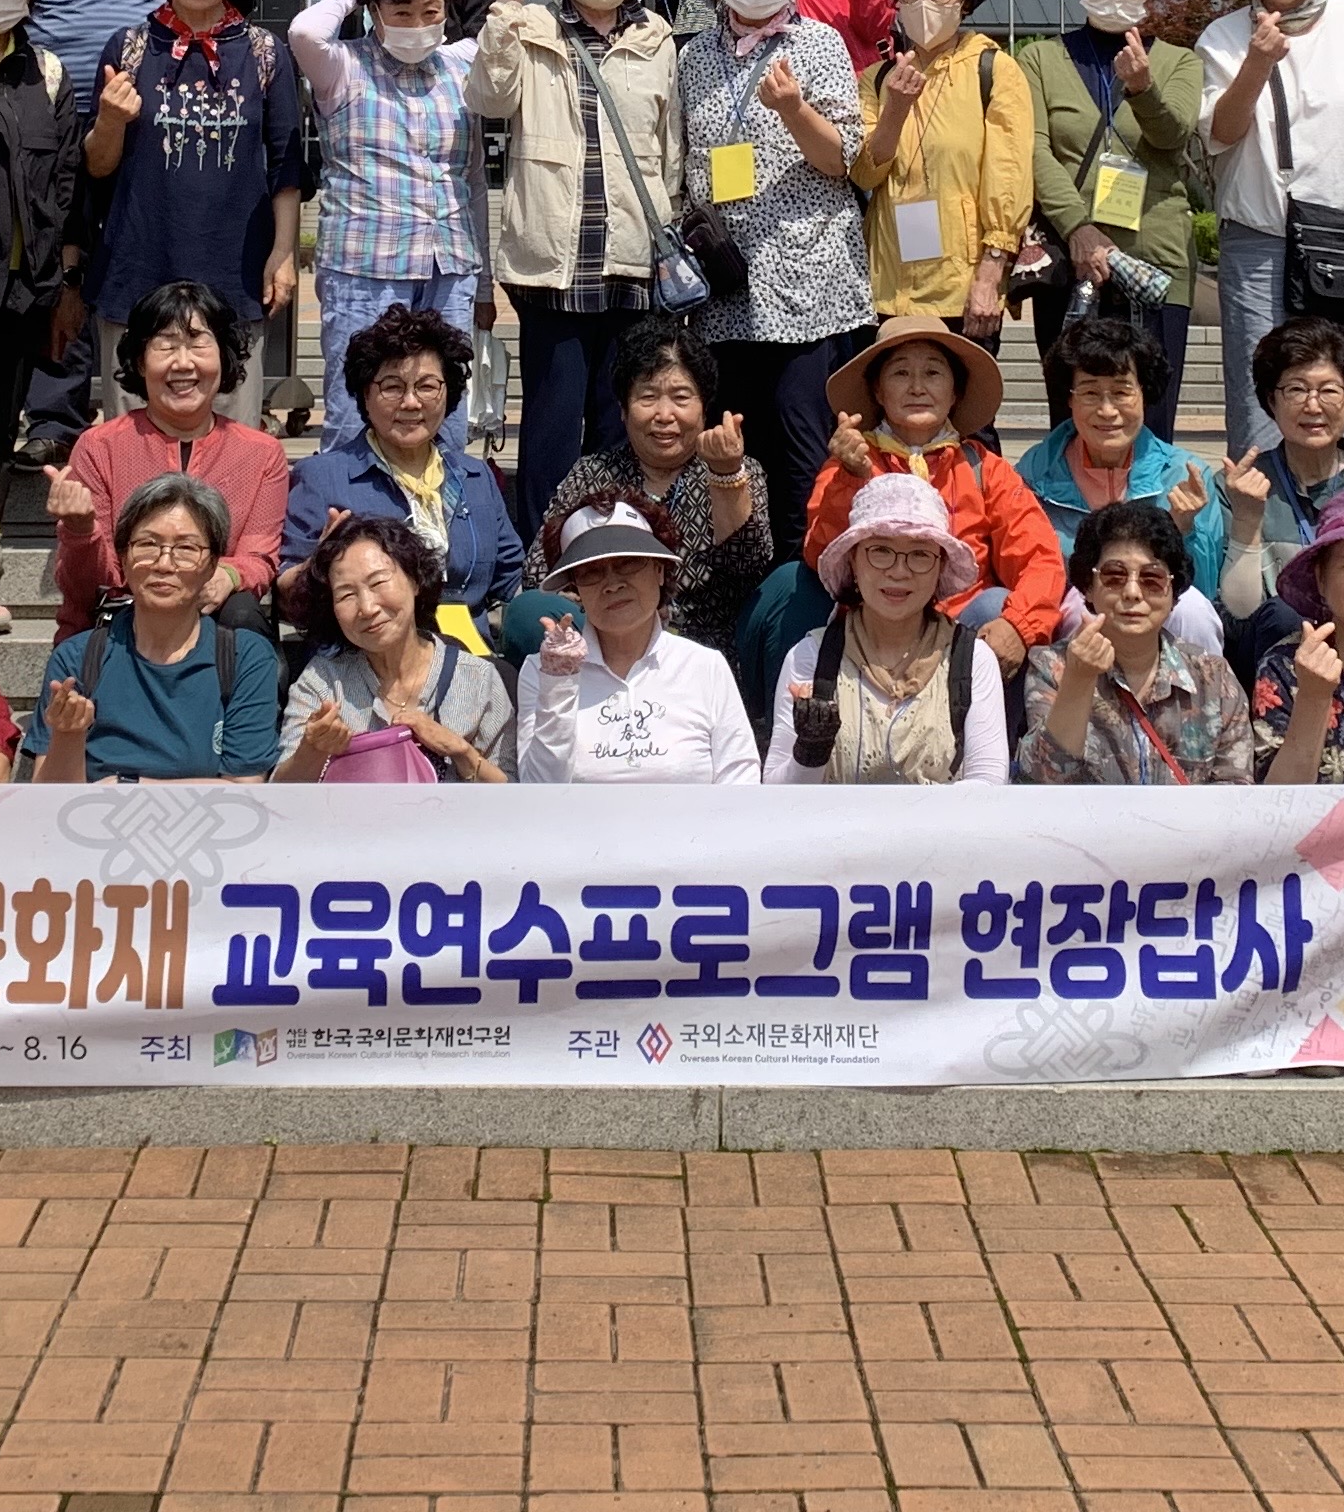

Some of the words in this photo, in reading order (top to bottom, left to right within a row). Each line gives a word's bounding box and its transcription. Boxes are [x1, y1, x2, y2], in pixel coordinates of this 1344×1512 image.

[211, 880, 933, 1006] 교육연수프로그램
[959, 873, 1313, 1000] 현장답사
[286, 1028, 308, 1038] 사단
[286, 1039, 307, 1048] 법인
[311, 1025, 510, 1048] 한국국외문화재연구원
[568, 1030, 620, 1059] 주관
[679, 1023, 879, 1049] 국외소재문화재재단
[24, 1035, 47, 1061] 8.
[56, 1035, 87, 1060] 16
[139, 1035, 192, 1062] 주최
[286, 1051, 325, 1060] Overseas
[328, 1051, 357, 1059] Korean
[360, 1050, 391, 1059] Cultural
[394, 1050, 428, 1059] Heritage
[431, 1050, 469, 1058] Research
[472, 1049, 511, 1059] Institution
[680, 1054, 720, 1064] Overseas
[722, 1054, 753, 1063] Korean
[755, 1054, 790, 1063] Cultural
[792, 1055, 828, 1065] Heritage
[831, 1055, 880, 1064] Foundation
